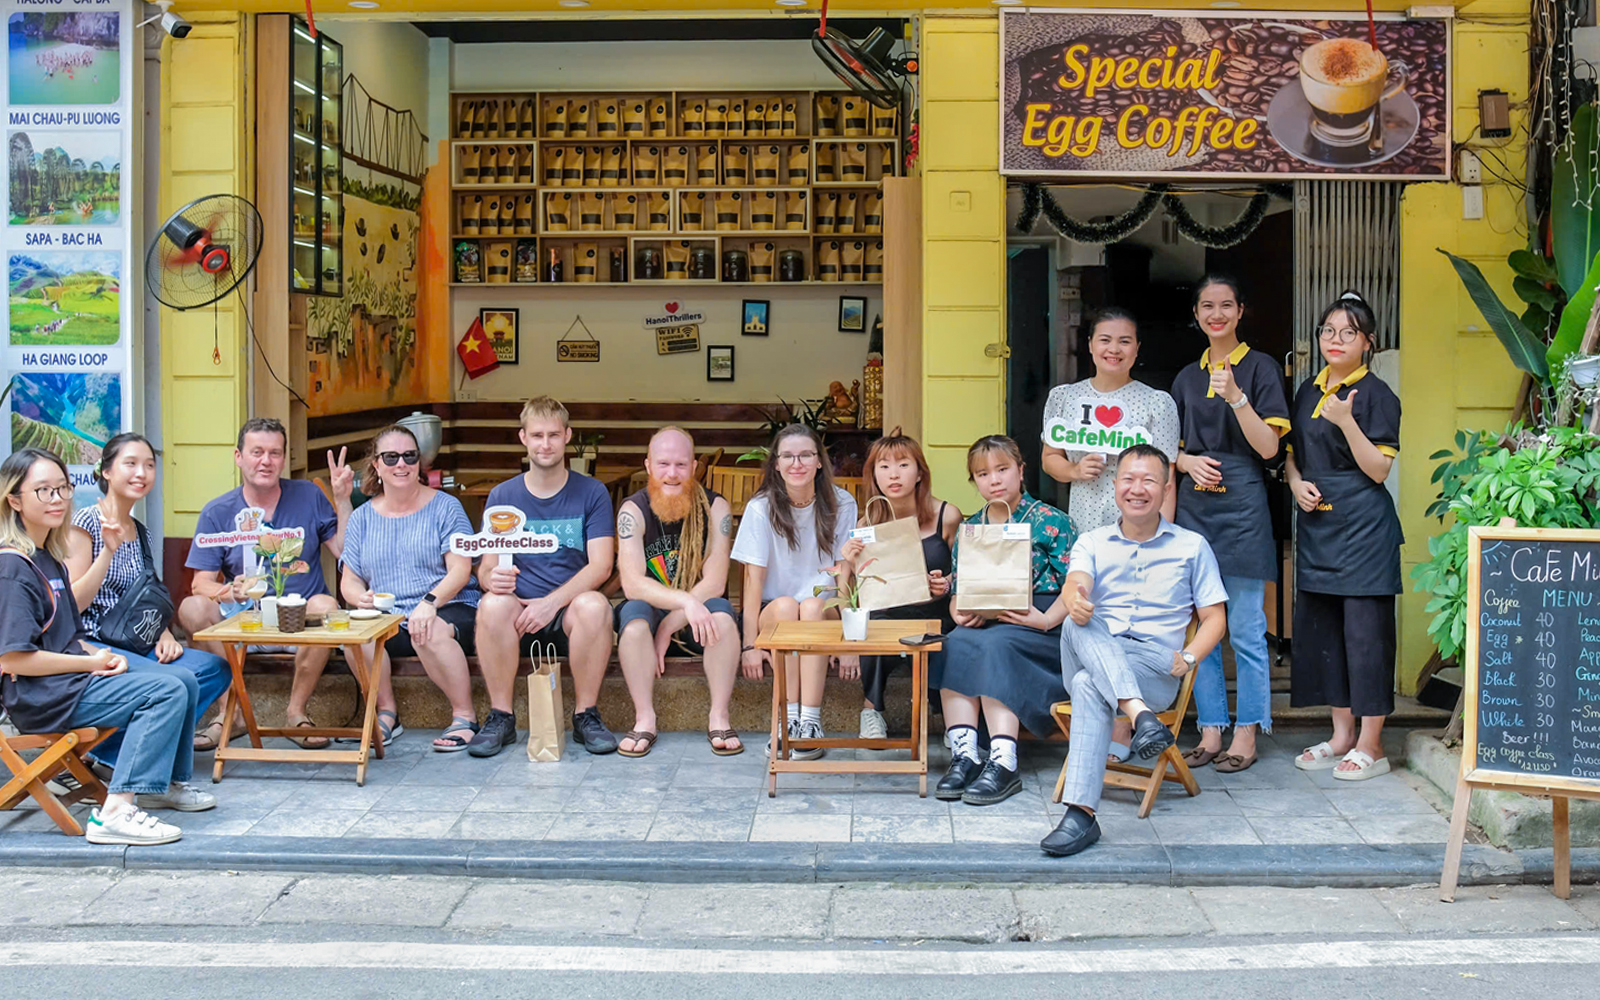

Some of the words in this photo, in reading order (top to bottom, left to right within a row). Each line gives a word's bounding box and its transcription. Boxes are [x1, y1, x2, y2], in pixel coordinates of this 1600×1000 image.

[1058, 43, 1224, 98] Special
[9, 112, 30, 125] MAI
[32, 112, 80, 125] CHAU-PU
[83, 112, 120, 125] LUONG
[1021, 102, 1103, 158] Egg
[1116, 103, 1258, 158] Coffee
[25, 232, 53, 245] SAPA
[62, 232, 85, 245] BAC
[87, 232, 103, 245] HA
[645, 313, 702, 325] HanoiThrillers
[22, 353, 38, 365] HA
[39, 353, 76, 365] GIANG
[79, 353, 108, 365] LOOP
[1080, 404, 1092, 425] I
[529, 524, 561, 534] ACK
[455, 537, 554, 551] EggCoffeeClass
[1484, 588, 1521, 614] Coffee
[1542, 589, 1593, 607] MENU
[1480, 612, 1522, 627] Coconut
[1535, 612, 1554, 627] 40
[1486, 629, 1508, 648] Egg
[1534, 631, 1555, 647] 40
[1484, 651, 1513, 667] Salt
[1535, 651, 1556, 669] 40
[1483, 671, 1517, 686] Black
[1535, 672, 1555, 688] 30
[1482, 690, 1523, 706] Brown
[1535, 693, 1555, 708] 30
[1481, 710, 1525, 727] White
[1536, 713, 1554, 727] 30
[1502, 731, 1530, 744] Beer
[1477, 742, 1497, 763] Egg
[1528, 744, 1555, 760] class
